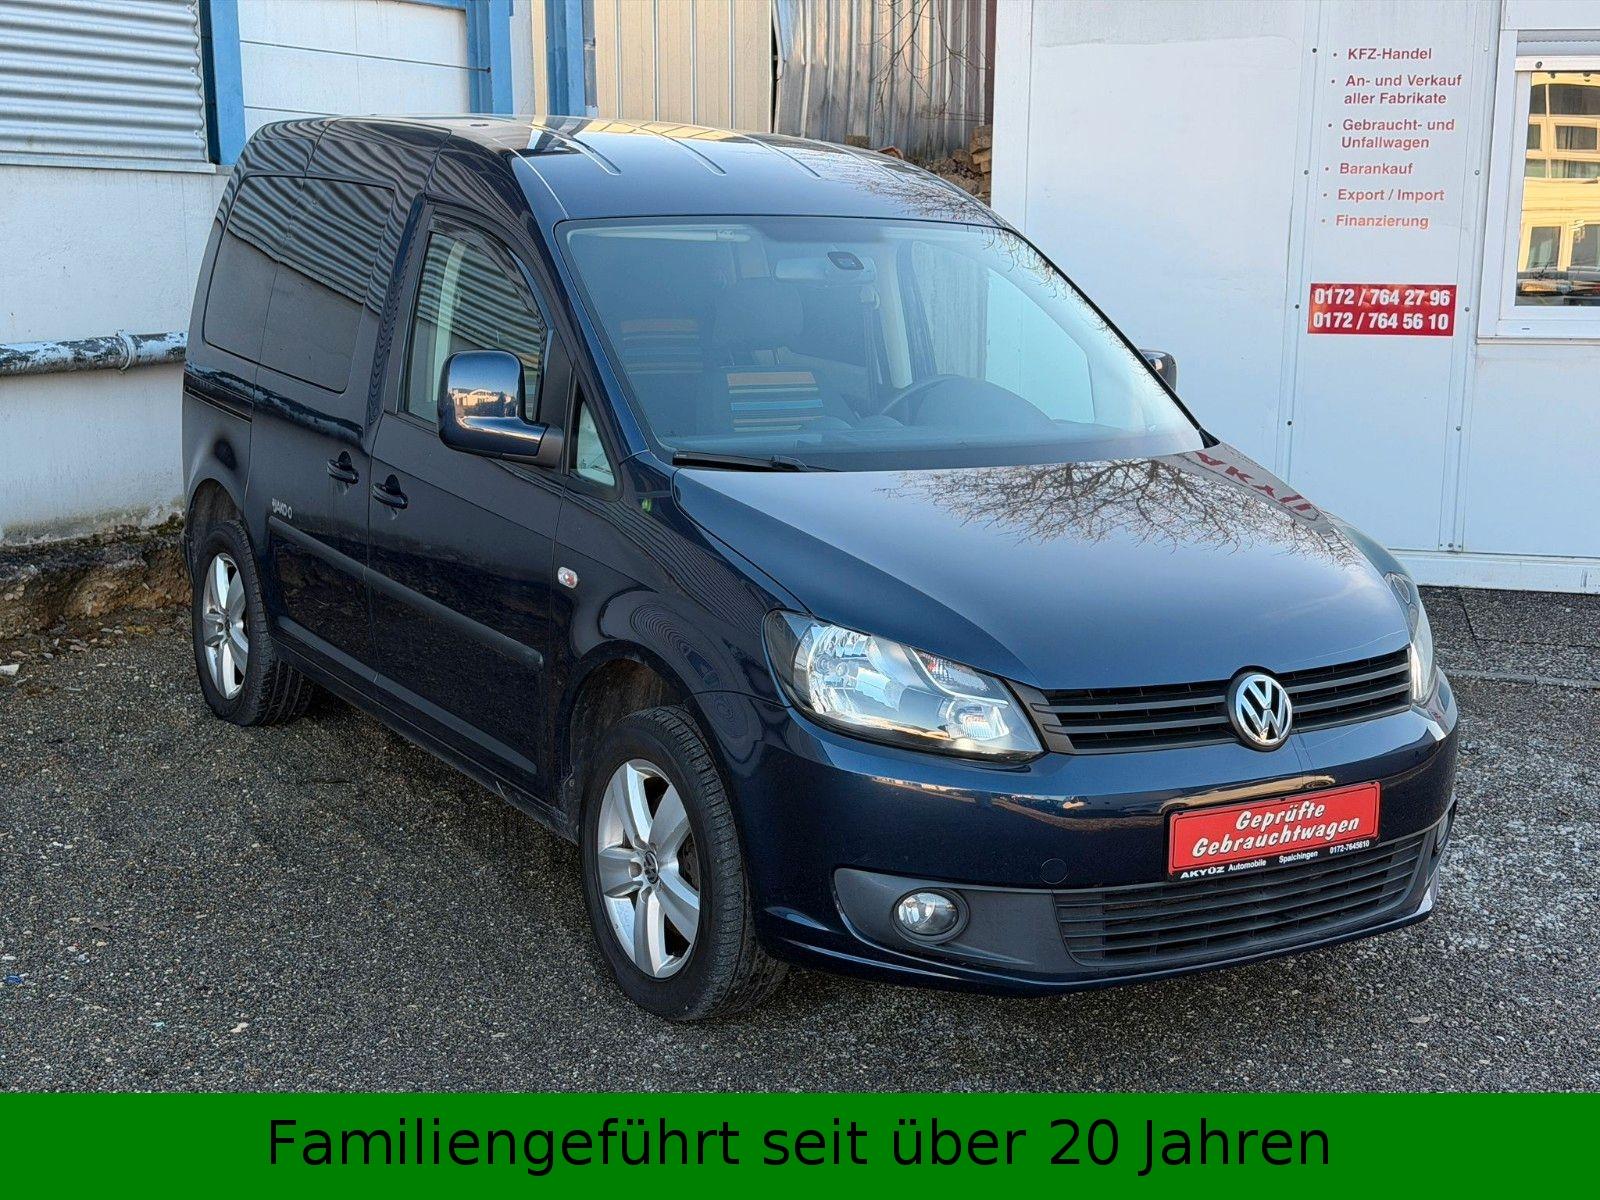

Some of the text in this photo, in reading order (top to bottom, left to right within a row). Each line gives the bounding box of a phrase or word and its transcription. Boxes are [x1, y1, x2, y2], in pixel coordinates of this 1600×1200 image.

[1347, 48, 1432, 60] KFZ-Handel
[1345, 74, 1462, 87] An- und Verkauf
[1344, 92, 1447, 104] aller Fabrikate
[1342, 118, 1455, 131] Gebraucht- und
[1341, 136, 1429, 151] Unfallwagen
[1339, 162, 1413, 174] Barankauf
[1338, 188, 1385, 203] Export
[1397, 189, 1445, 203] Import
[1336, 214, 1429, 230] Finanzierung
[1314, 288, 1450, 306] 0172 / 764 27 96
[1313, 311, 1449, 330] 0172 / 764 56 10
[1236, 674, 1292, 746] VW
[1236, 800, 1325, 832] Geprüfte
[1192, 816, 1360, 858] Gebrauchtwagen
[1228, 858, 1267, 872] Automobile
